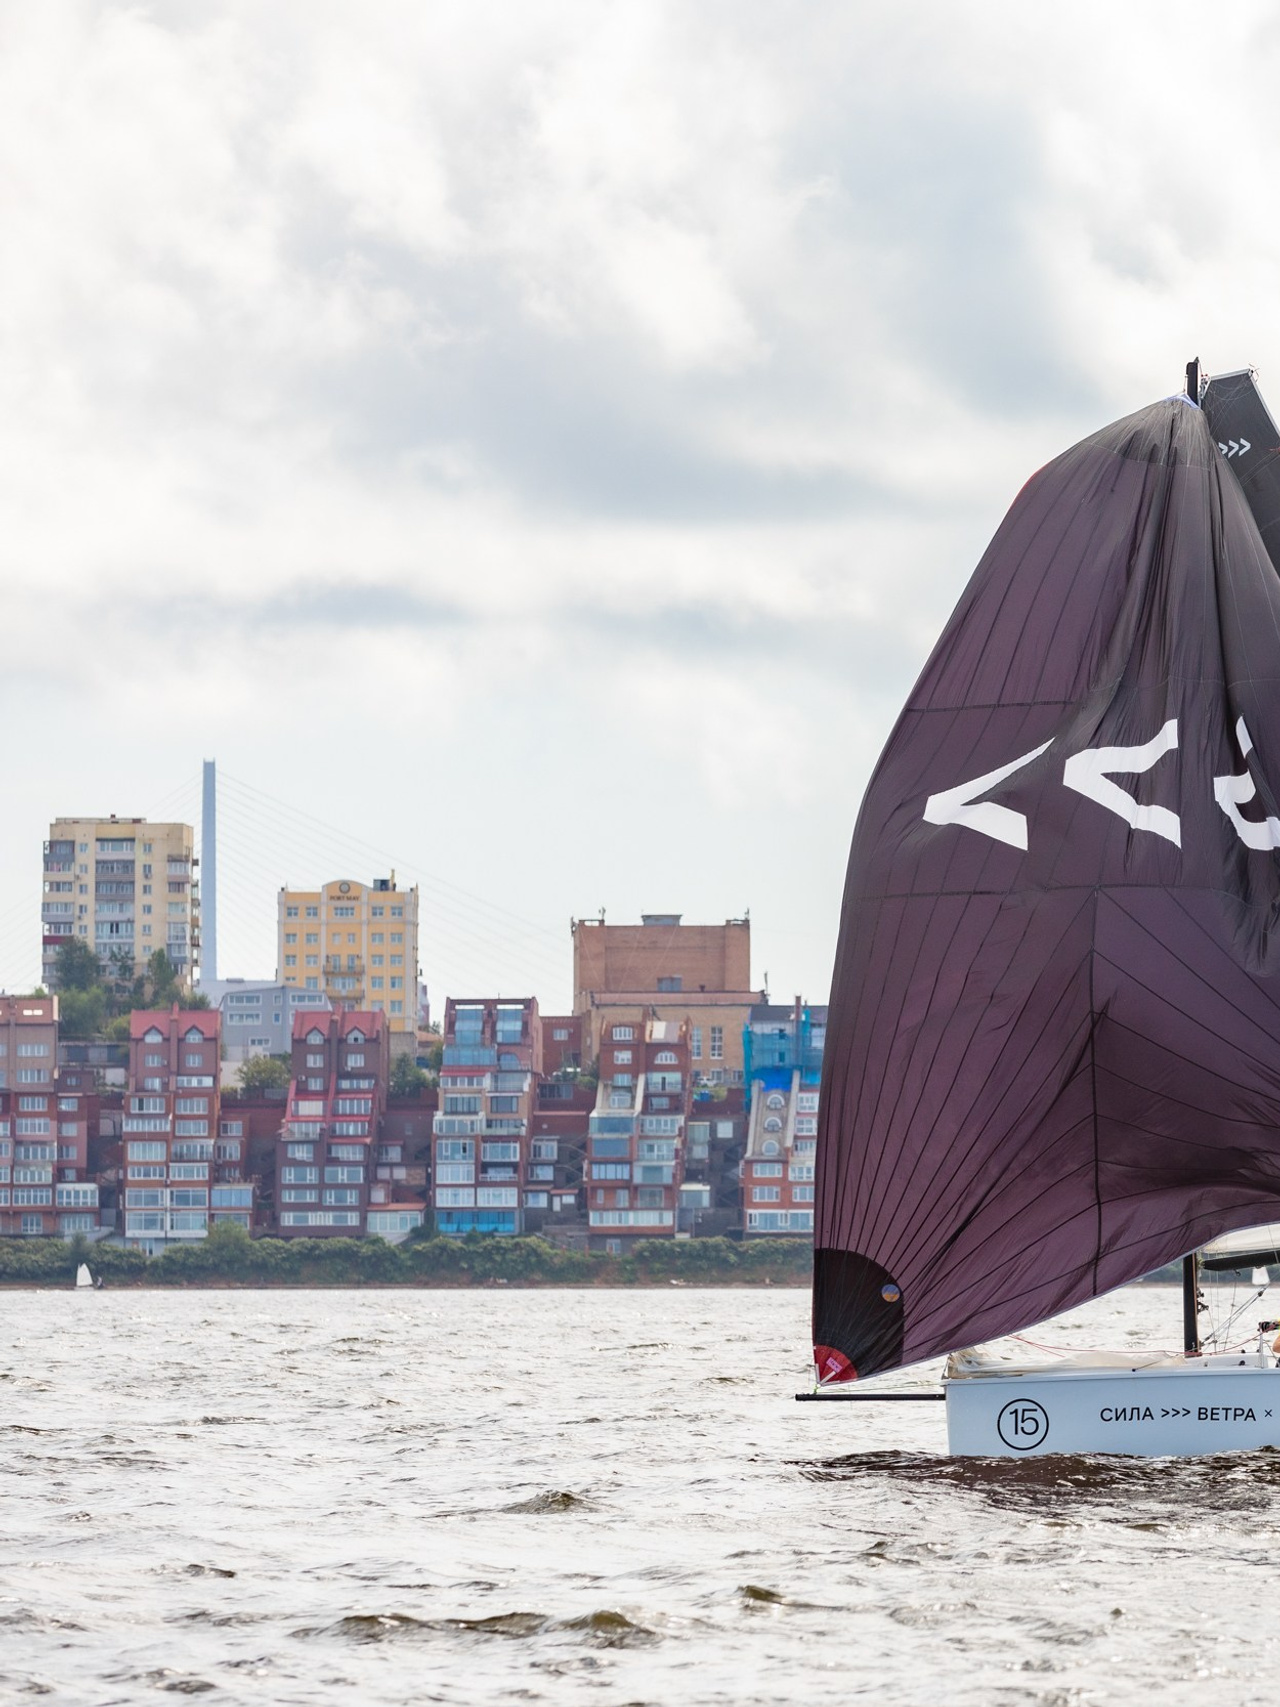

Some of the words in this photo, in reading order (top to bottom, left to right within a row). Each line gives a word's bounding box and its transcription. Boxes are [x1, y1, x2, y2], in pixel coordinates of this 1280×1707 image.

[1009, 1408, 1040, 1436] 15
[1100, 1407, 1154, 1422] СИЛА
[1197, 1407, 1257, 1421] ВЕТРА
